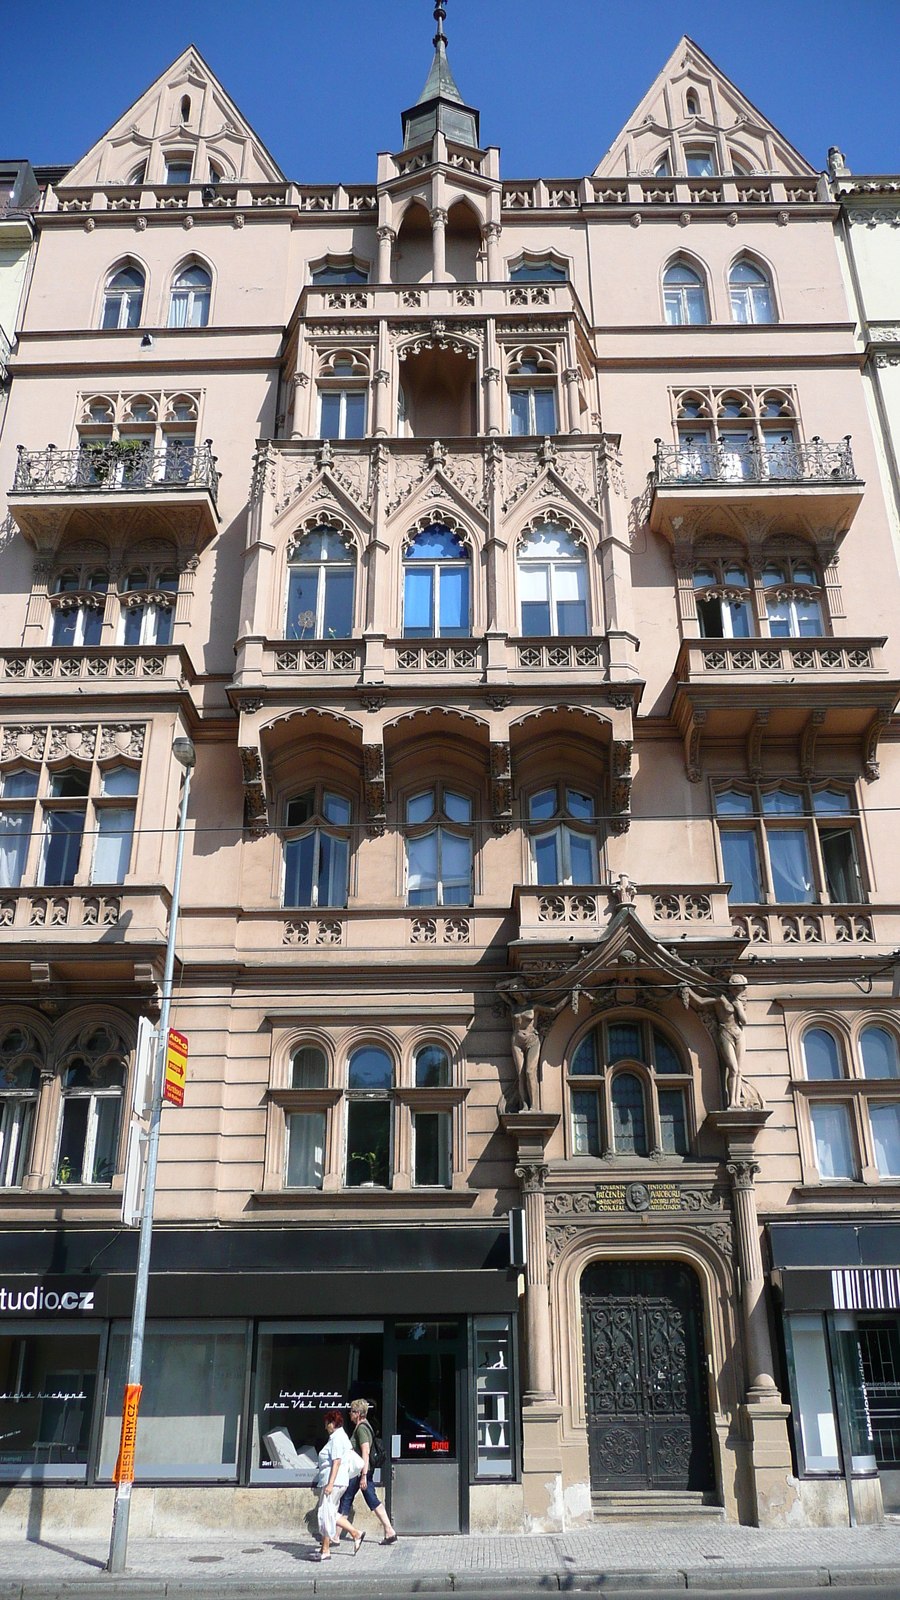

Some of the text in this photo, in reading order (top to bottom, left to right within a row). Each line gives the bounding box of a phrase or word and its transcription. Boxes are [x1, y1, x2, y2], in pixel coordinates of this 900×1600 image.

[279, 1389, 342, 1399] inspirace
[264, 1402, 289, 1411] pro
[291, 1400, 316, 1409] Váš
